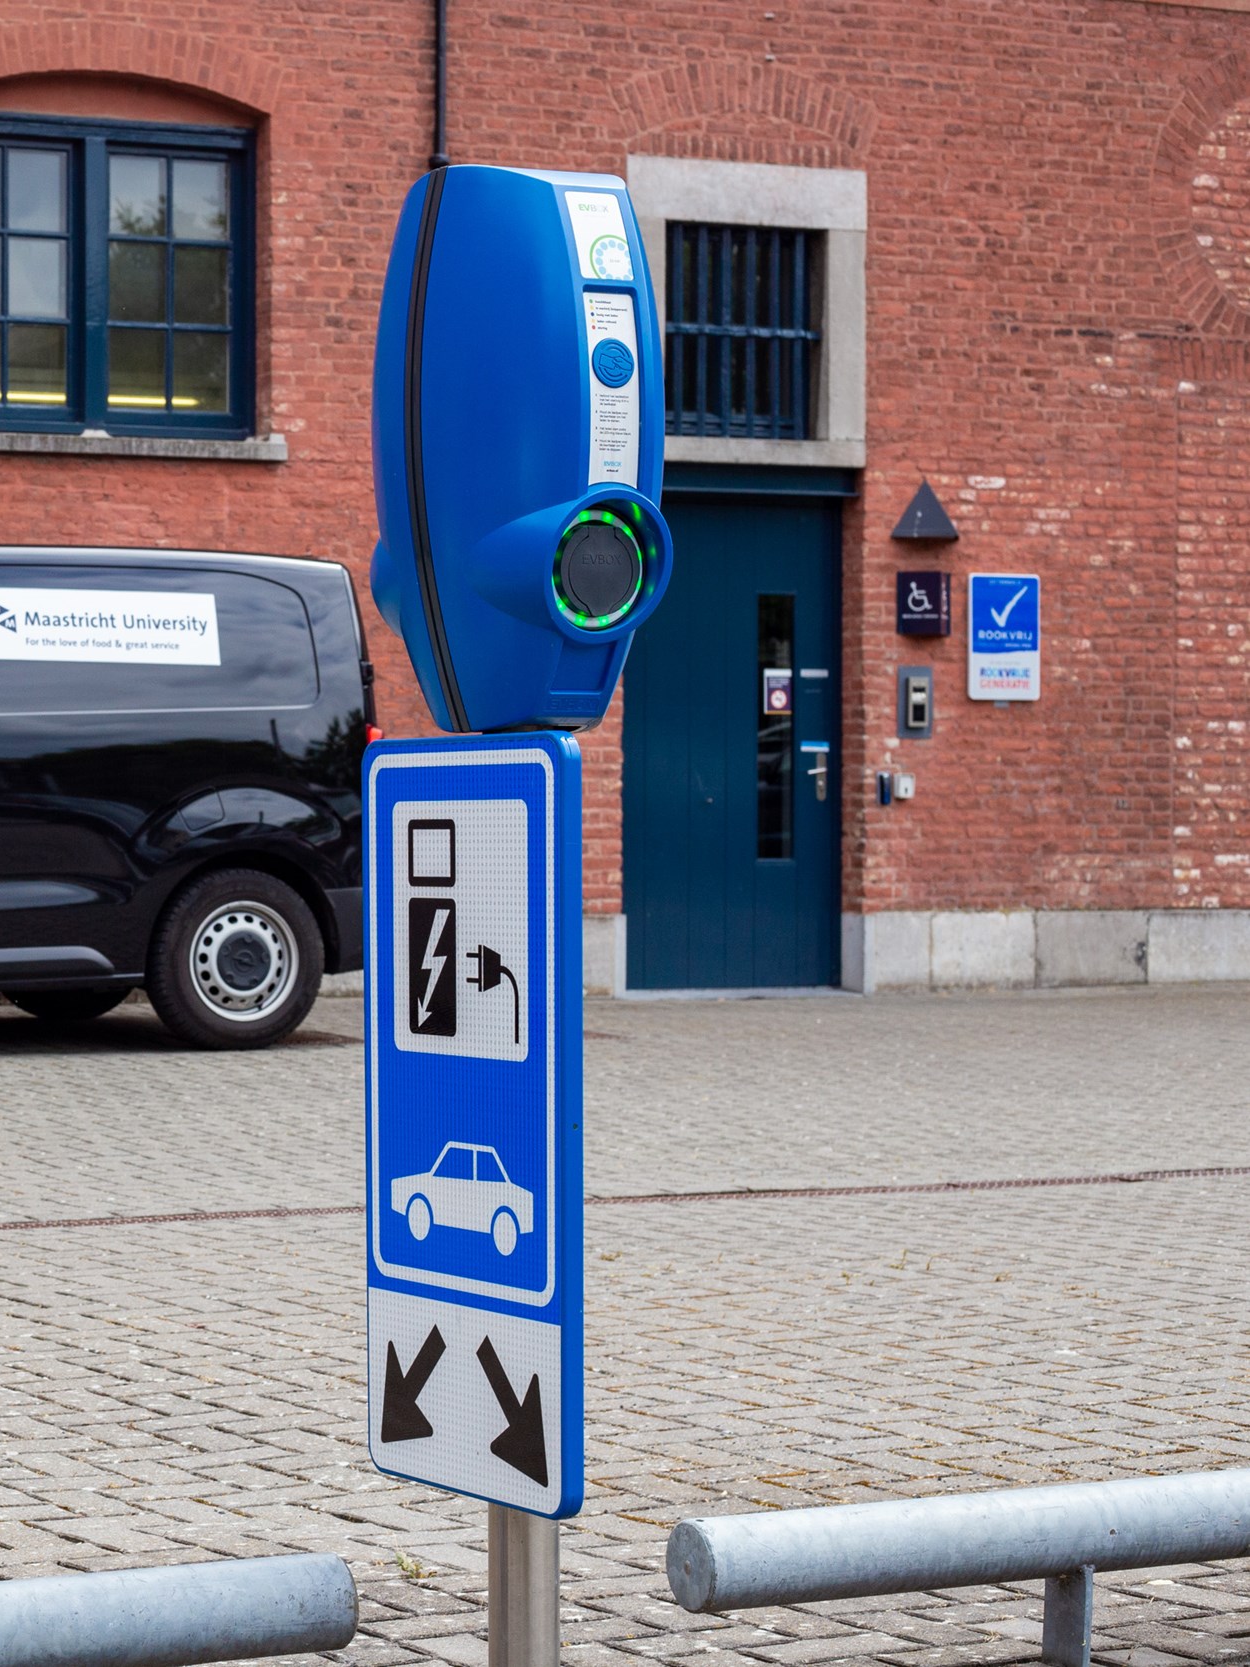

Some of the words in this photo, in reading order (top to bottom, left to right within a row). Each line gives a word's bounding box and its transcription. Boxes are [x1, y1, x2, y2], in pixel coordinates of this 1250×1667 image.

[578, 204, 608, 213] EVBX
[582, 553, 622, 565] EVBOX
[24, 611, 117, 629] Maastricht
[123, 614, 207, 636] University
[25, 637, 39, 646] For
[42, 638, 56, 646] the
[59, 638, 77, 647] love
[80, 638, 90, 647] of
[92, 639, 111, 648] food
[115, 640, 122, 648] &
[125, 641, 148, 650] great
[151, 641, 180, 650] service
